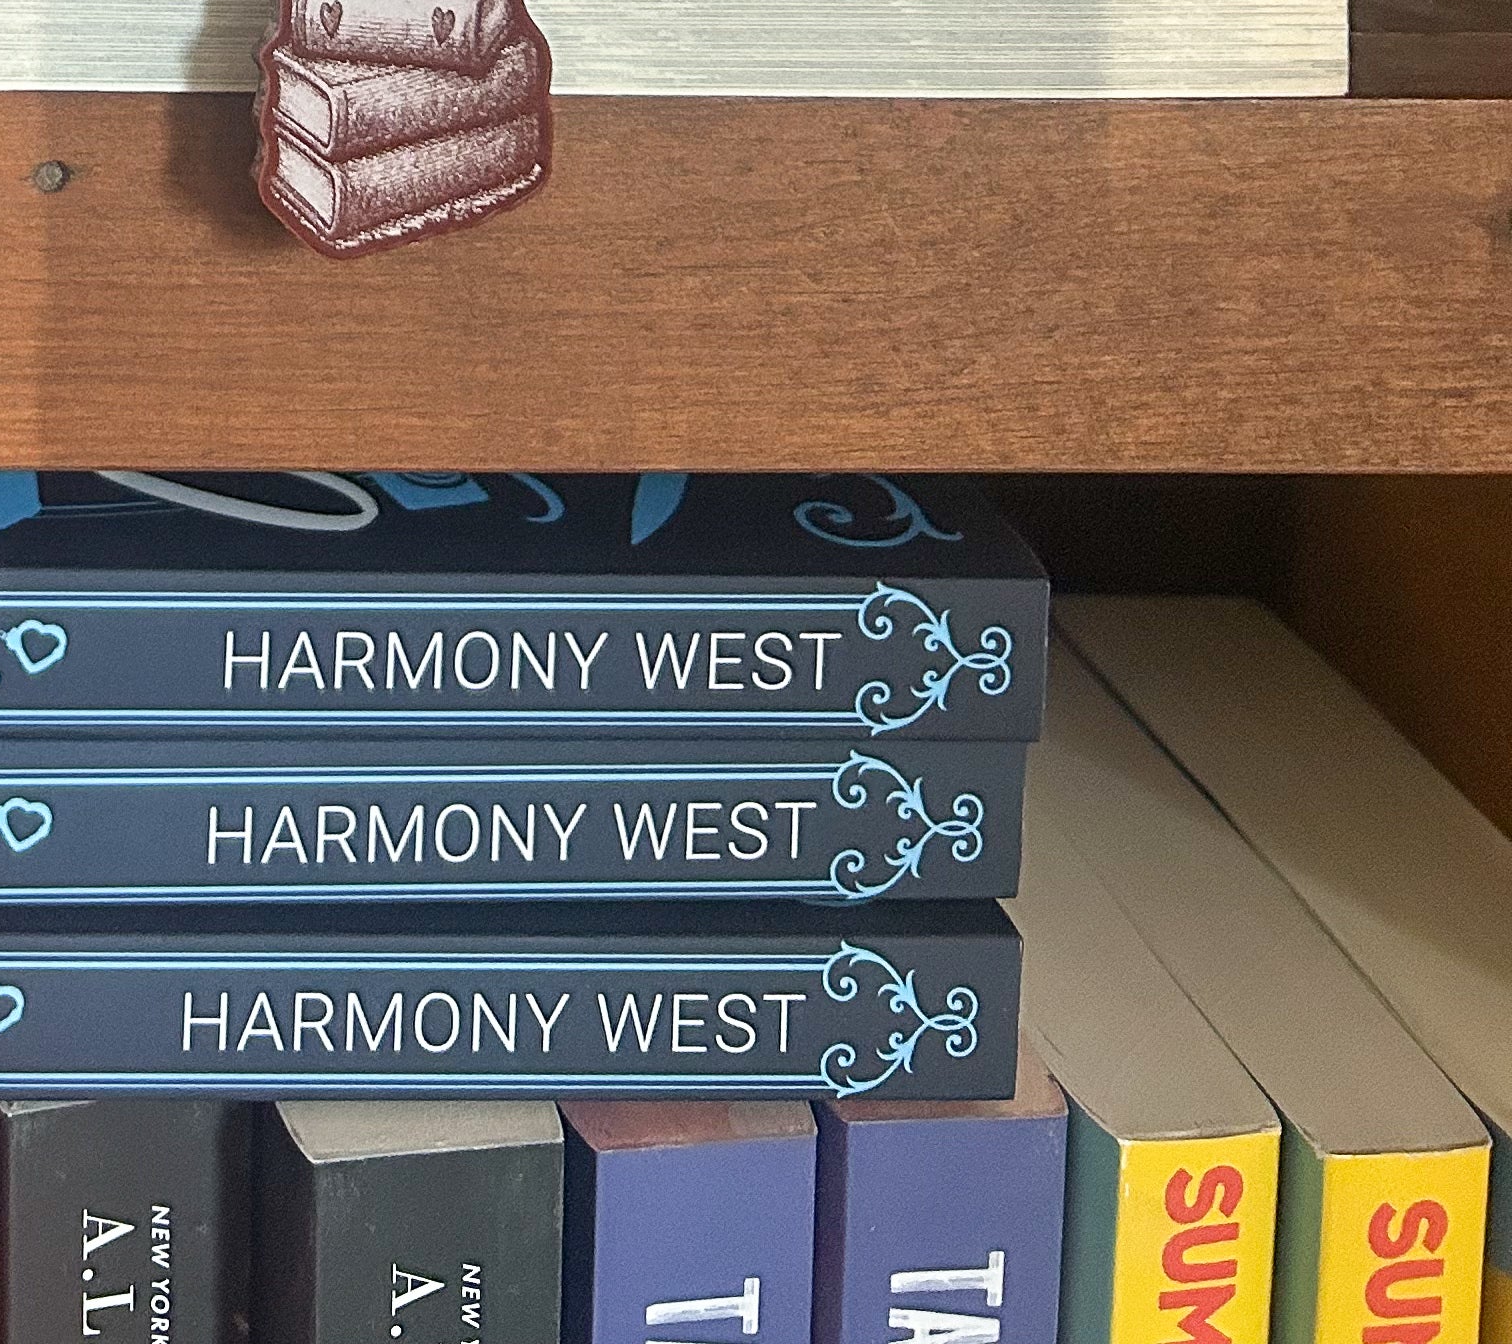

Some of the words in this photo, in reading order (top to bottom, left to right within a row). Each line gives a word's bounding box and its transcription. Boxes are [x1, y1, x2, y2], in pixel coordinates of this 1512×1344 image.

[222, 630, 608, 693] HARMONY
[636, 632, 842, 692] WEST
[206, 803, 587, 865] HARMONY
[613, 801, 817, 861] WEST
[180, 992, 571, 1054] HARMONY
[597, 992, 807, 1055] WEST
[151, 1205, 170, 1269] NEW
[461, 1263, 481, 1329] NEW
